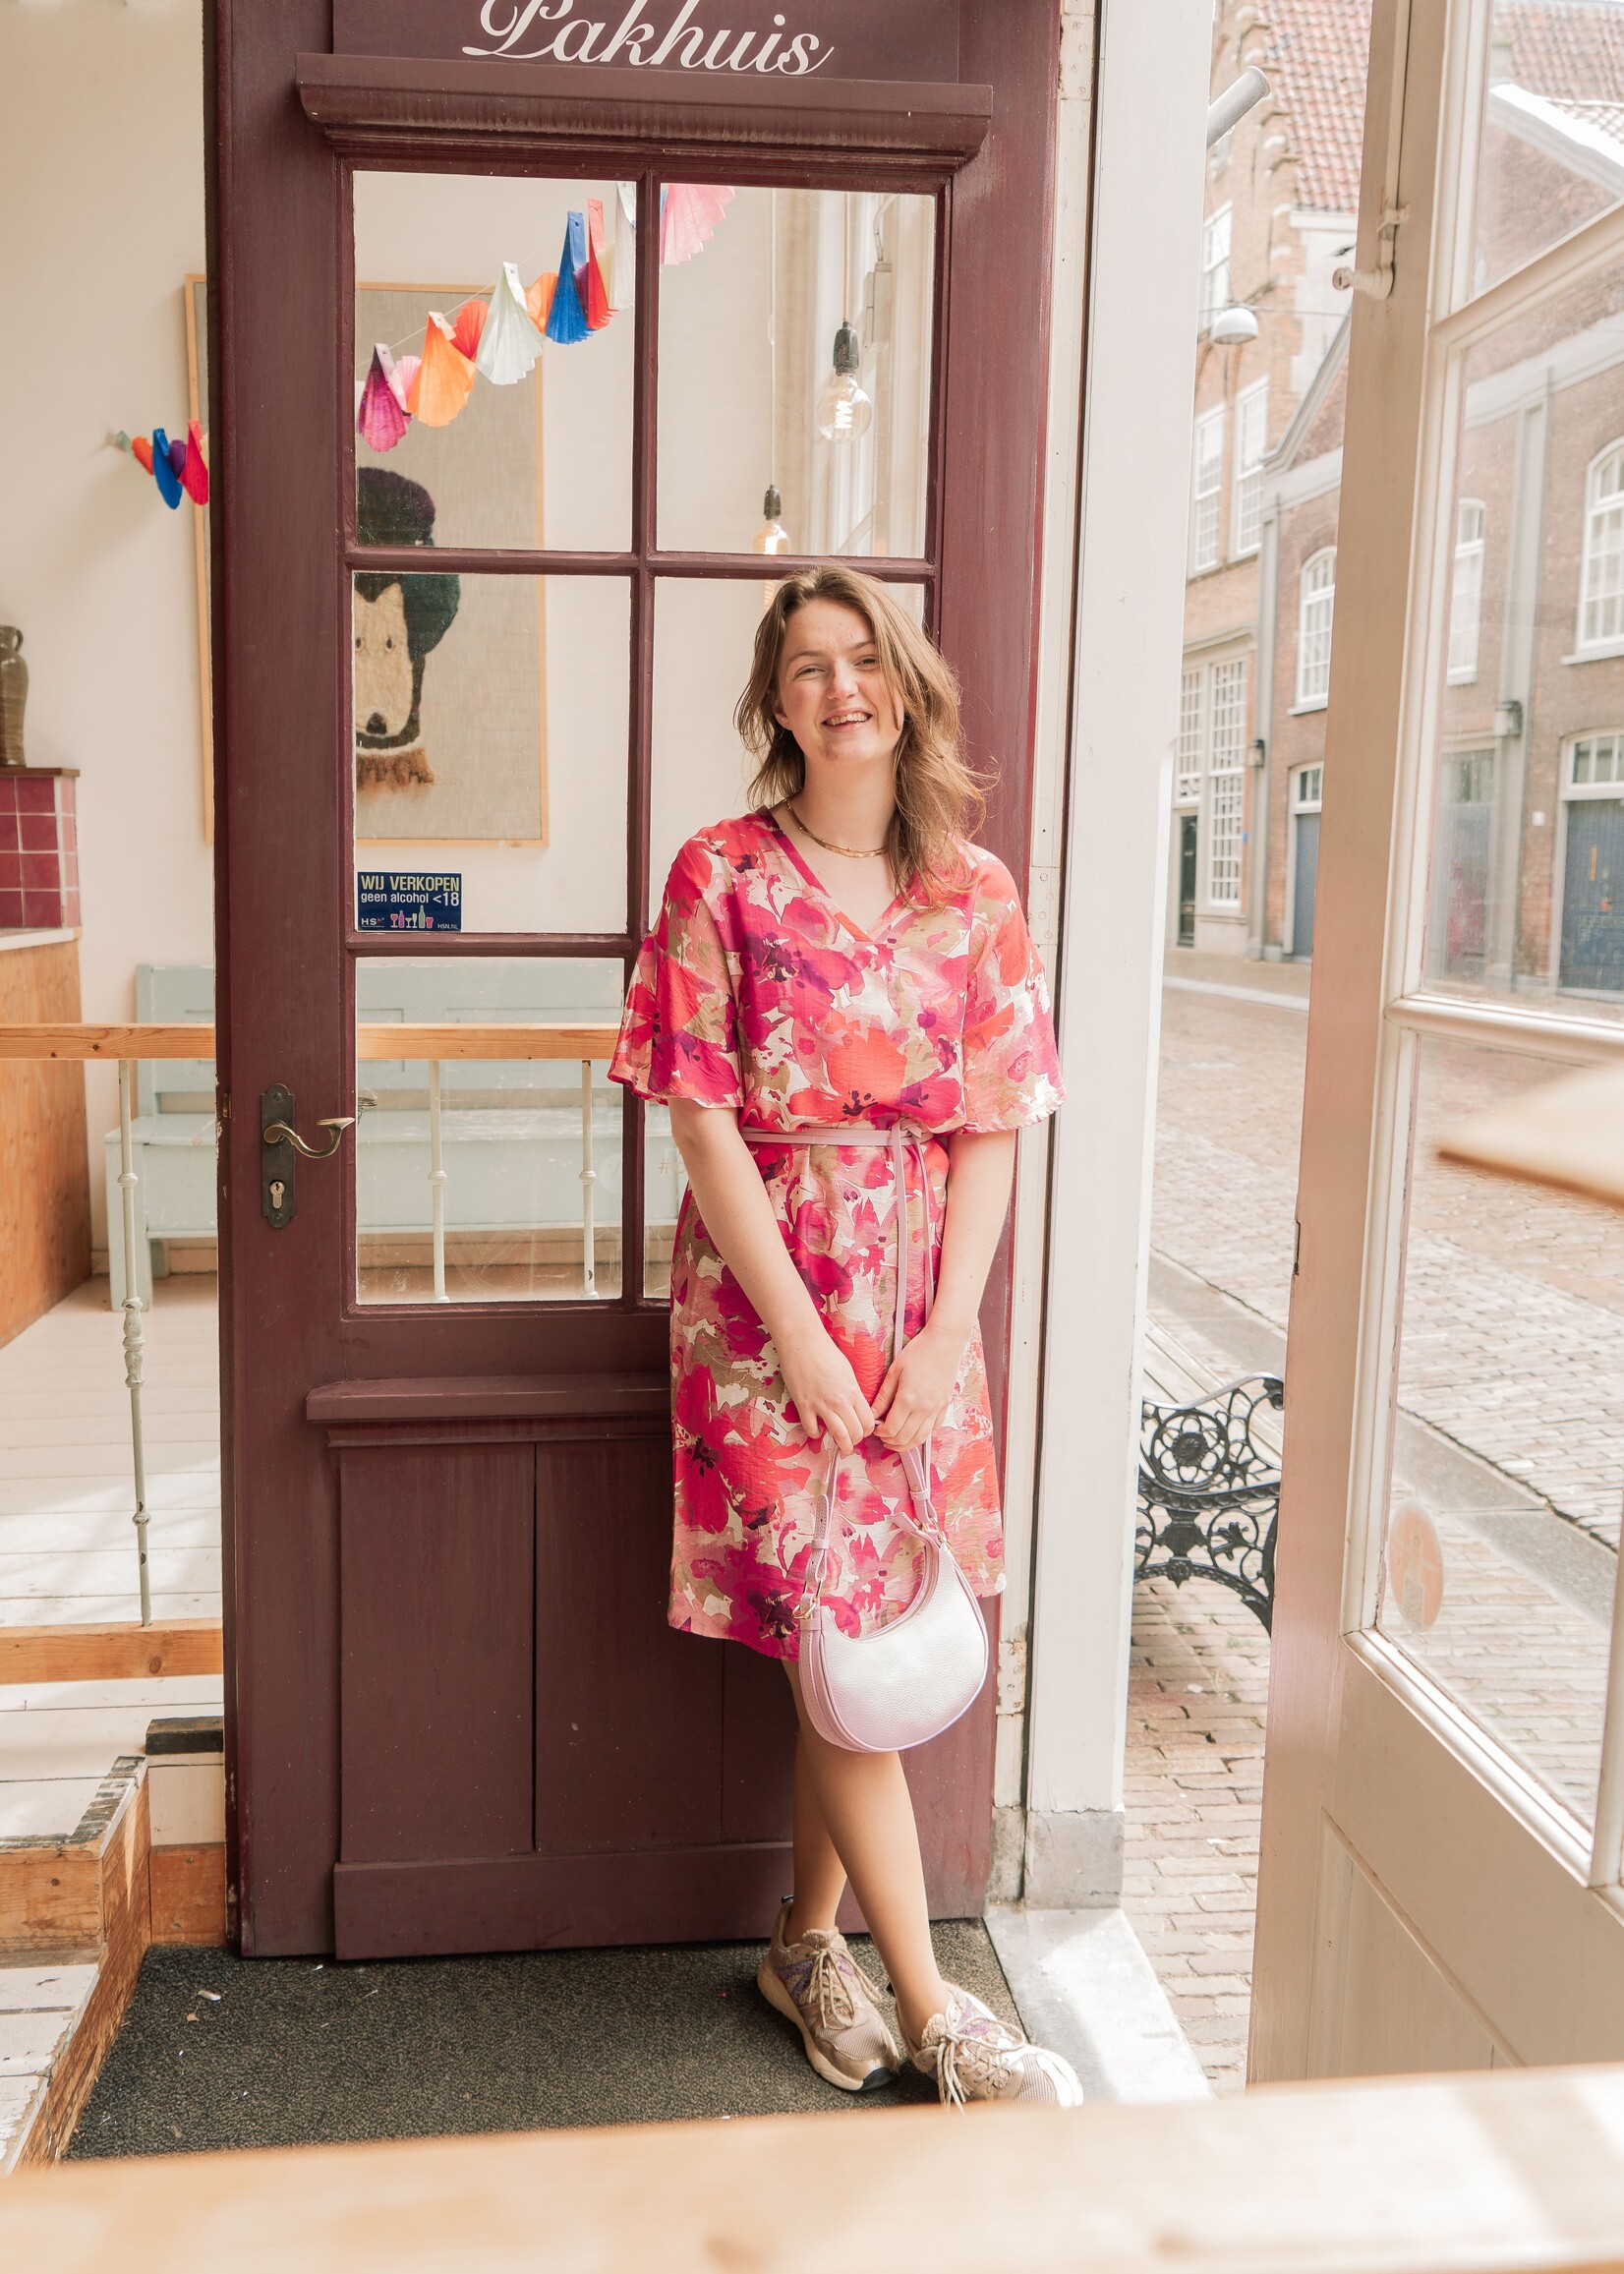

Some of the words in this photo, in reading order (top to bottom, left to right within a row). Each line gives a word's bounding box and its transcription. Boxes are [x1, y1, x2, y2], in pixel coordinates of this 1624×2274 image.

[461, 0, 835, 76] Pakhuis
[361, 875, 385, 891] WIJ
[389, 876, 460, 892] VERKOPEN
[361, 894, 387, 904] geen
[390, 893, 430, 904] alcohol
[433, 892, 459, 906] <18
